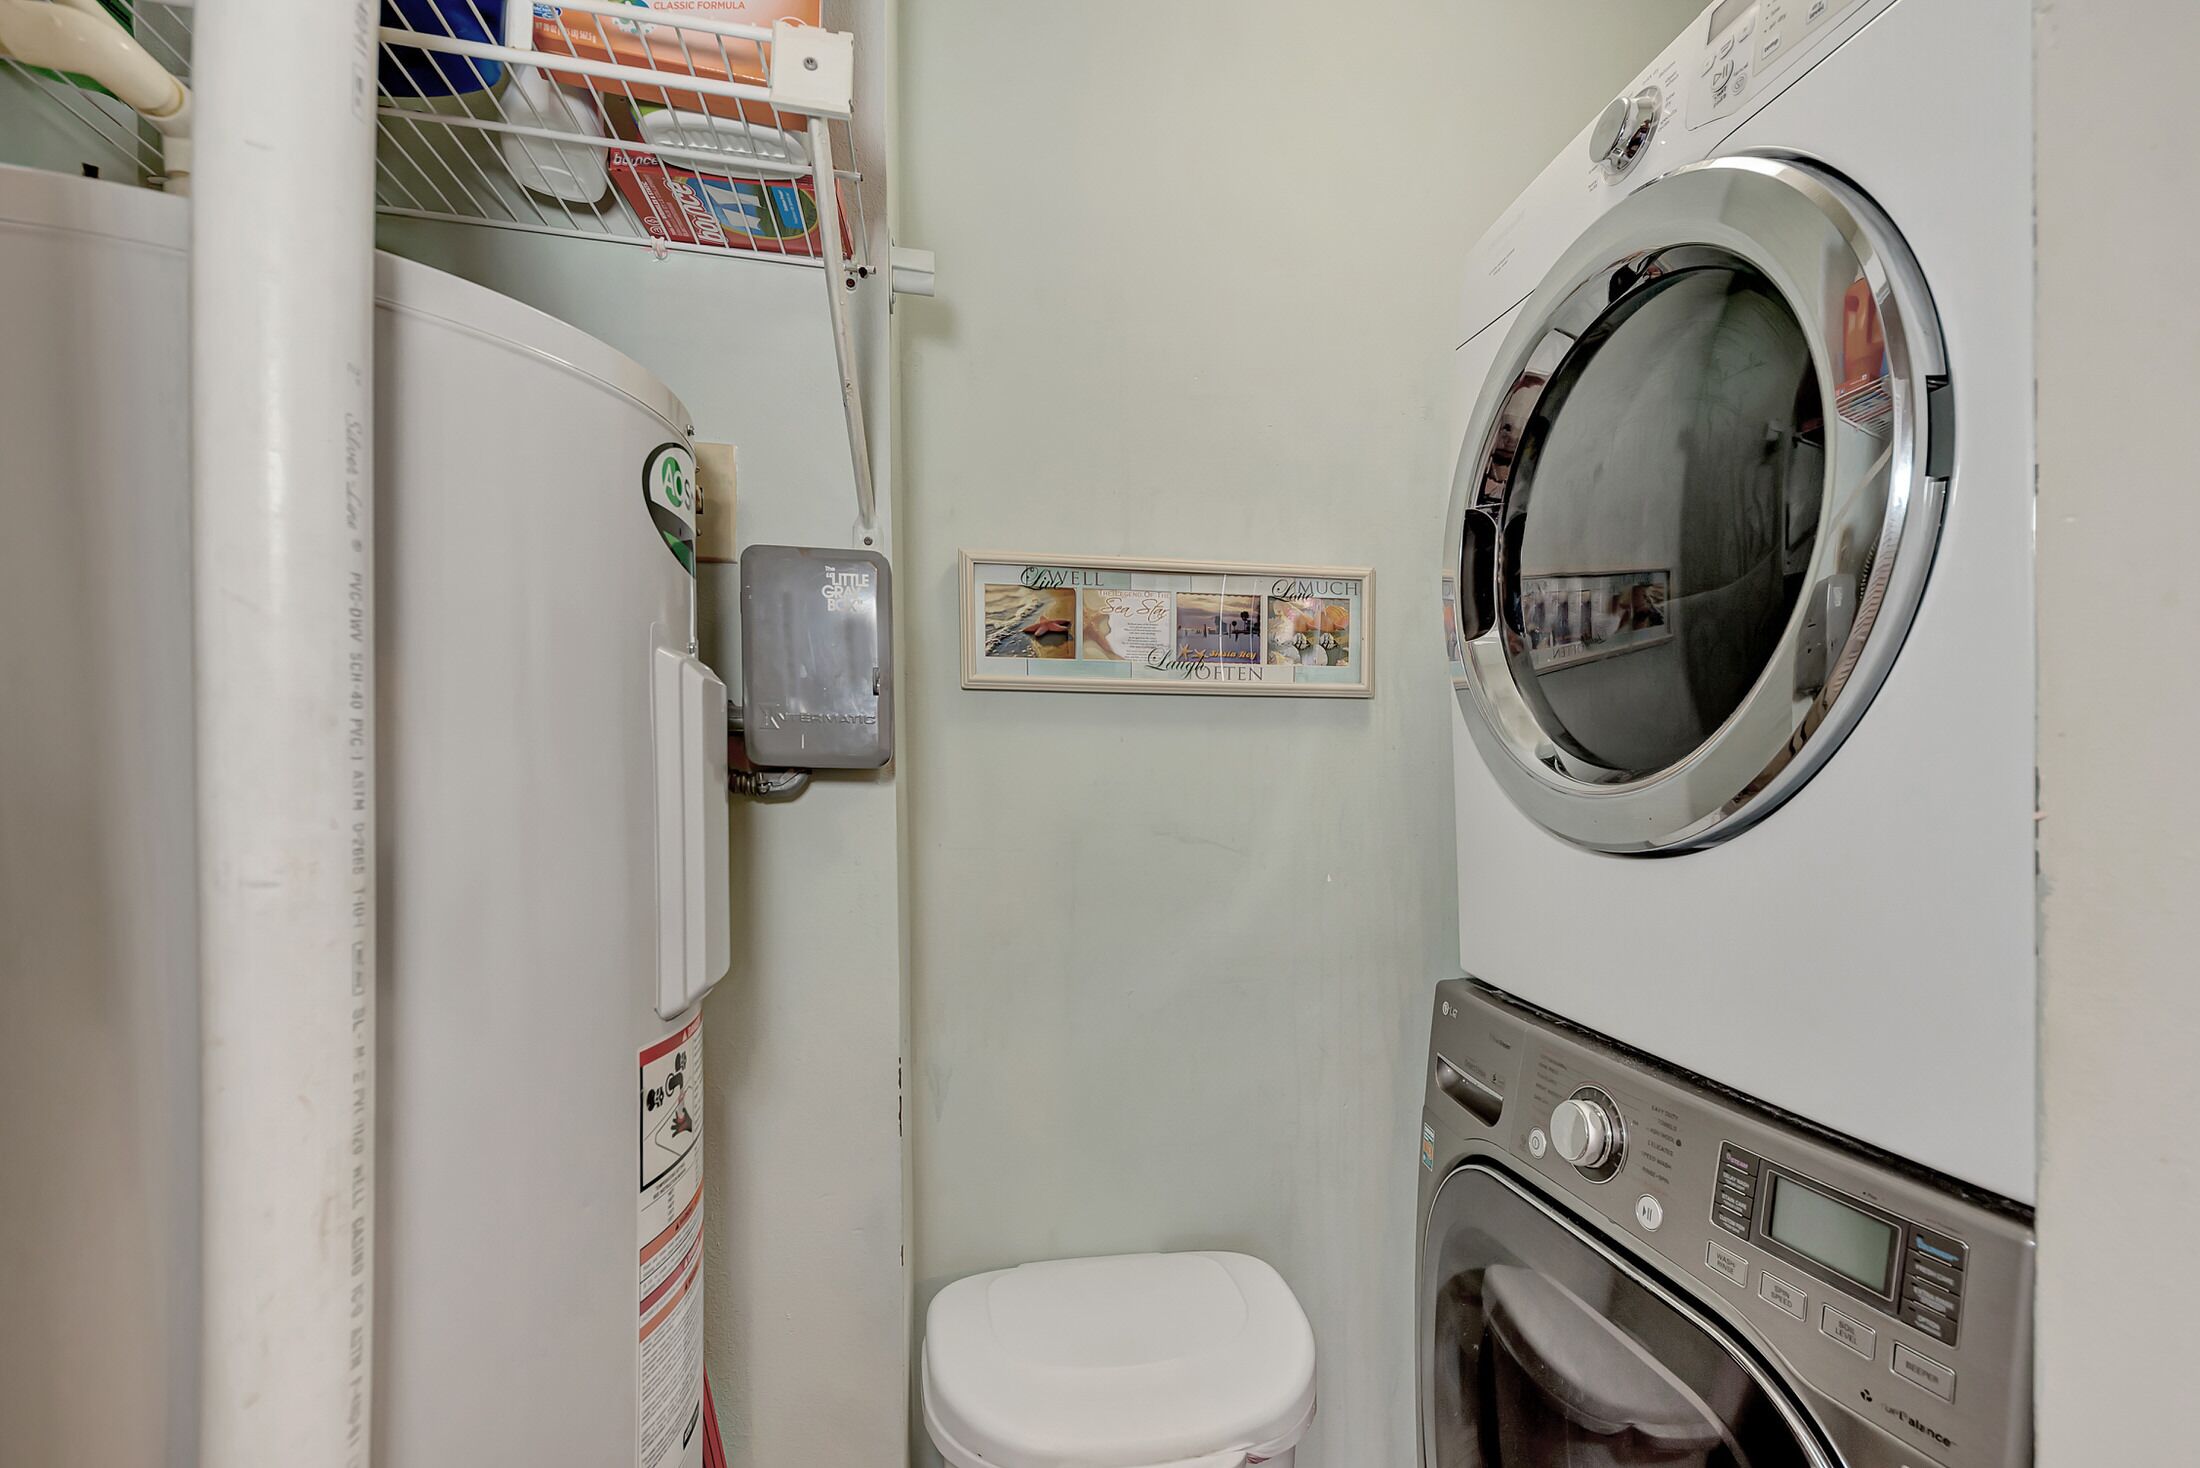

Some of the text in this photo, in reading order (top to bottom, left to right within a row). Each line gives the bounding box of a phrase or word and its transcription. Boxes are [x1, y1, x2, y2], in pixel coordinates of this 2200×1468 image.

[653, 1, 746, 10] CLASSIC FORMULA
[1020, 567, 1105, 591] Live WELL
[1271, 578, 1358, 601] Love MUCH
[1101, 596, 1170, 624] Sea Star
[1146, 648, 1264, 681] Laugh OFTEN
[1716, 1252, 1736, 1268] WASH
[1771, 1291, 1793, 1308] SPEED
[1773, 1284, 1790, 1299] SPIN
[1835, 1327, 1858, 1345] LEVEL
[1837, 1320, 1855, 1335] SOIL
[1904, 1361, 1940, 1384] BEEPER
